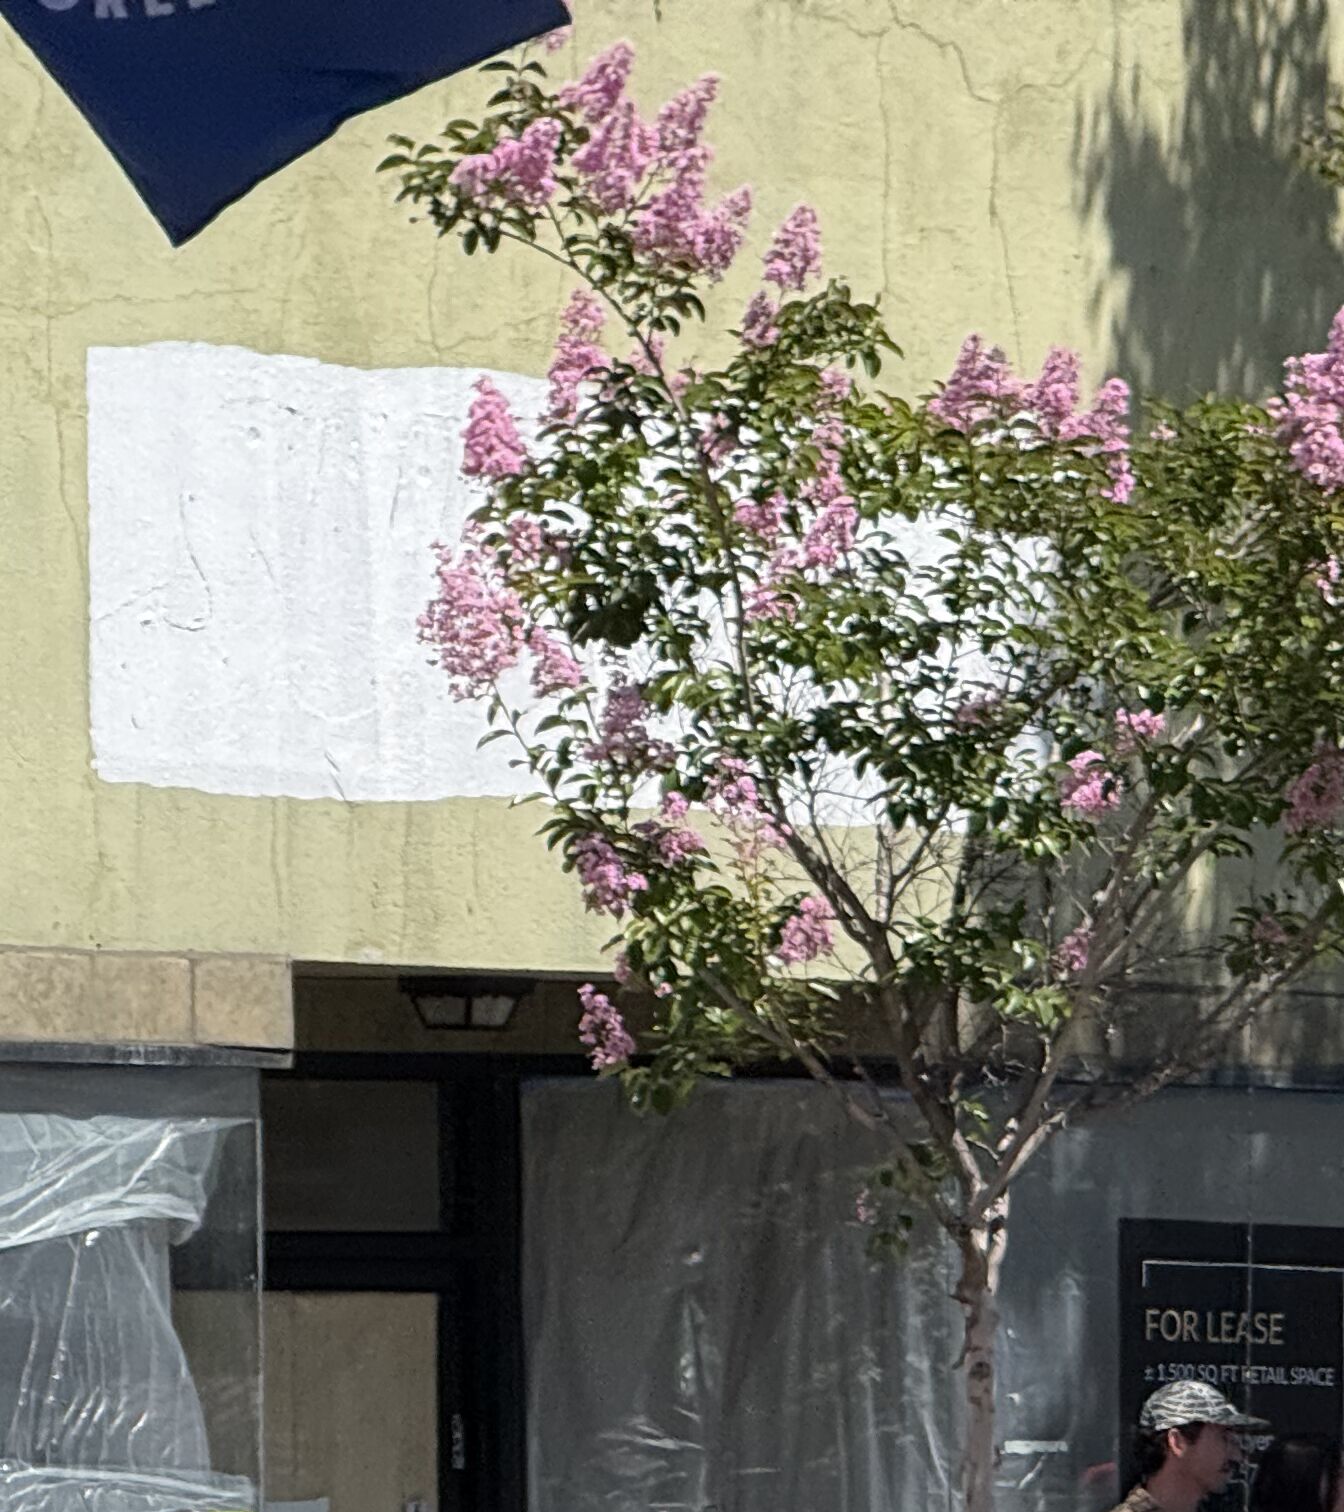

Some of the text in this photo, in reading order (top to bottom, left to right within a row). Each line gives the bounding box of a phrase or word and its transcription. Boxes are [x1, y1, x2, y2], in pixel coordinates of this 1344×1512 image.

[1145, 1308, 1285, 1345] FOR LEASE
[1198, 1364, 1218, 1385] SQ
[1221, 1365, 1239, 1383] FT
[1241, 1365, 1288, 1385] RETAIL
[1290, 1367, 1334, 1387] SPACE
